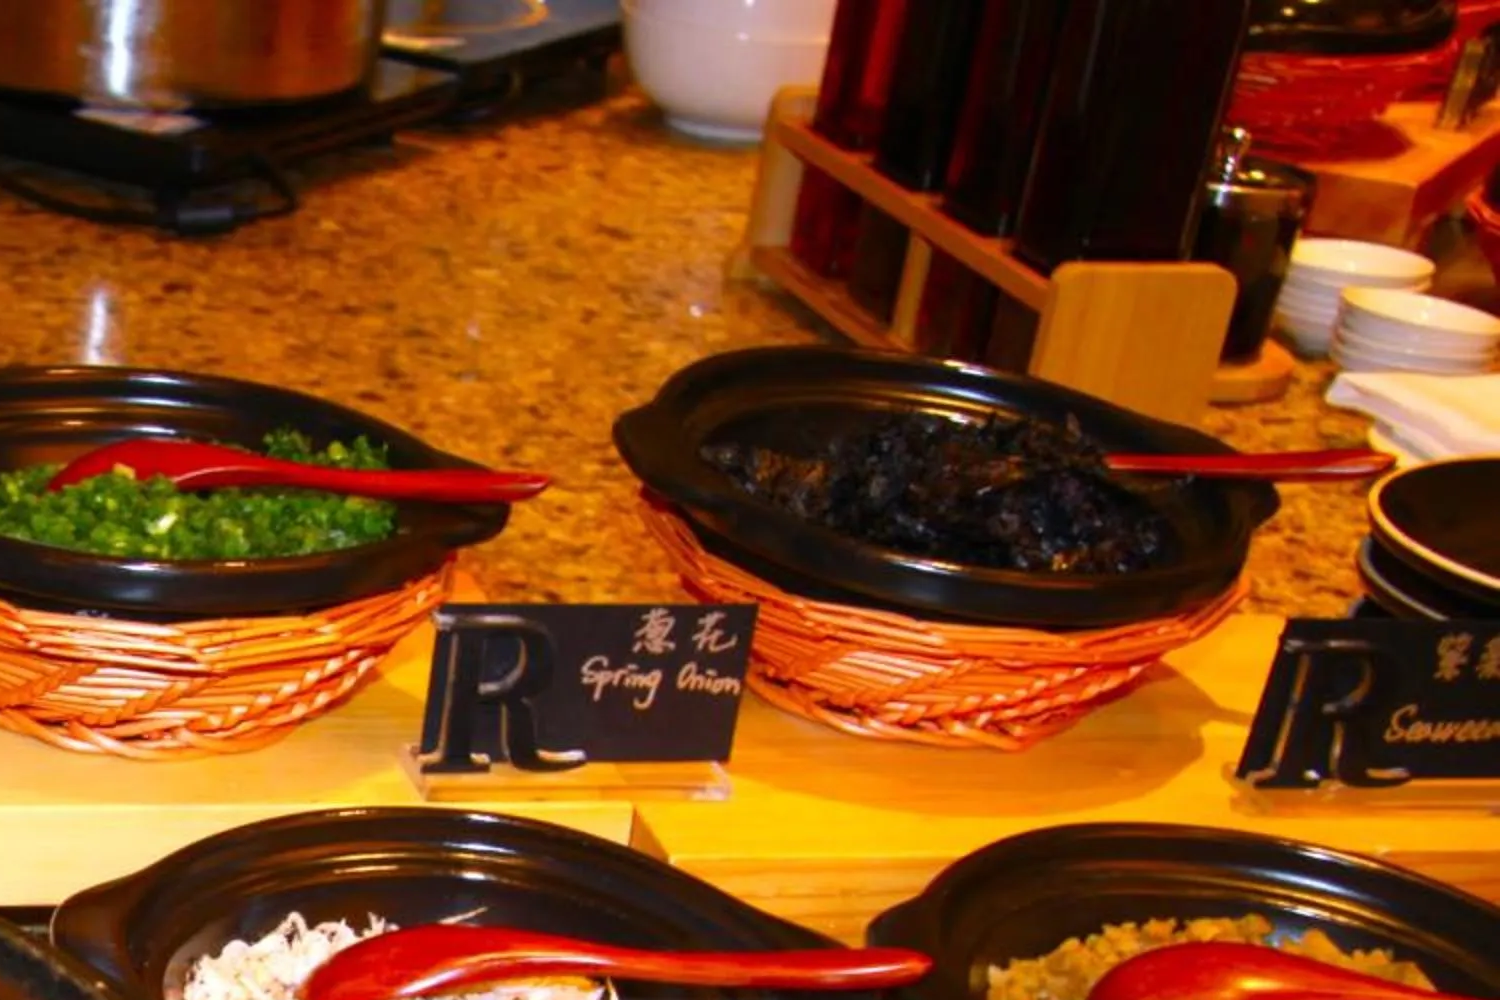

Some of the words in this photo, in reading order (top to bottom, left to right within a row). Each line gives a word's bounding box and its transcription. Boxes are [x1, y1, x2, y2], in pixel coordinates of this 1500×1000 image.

[413, 608, 588, 774] R
[580, 655, 663, 710] Spring
[675, 660, 742, 697] Onion
